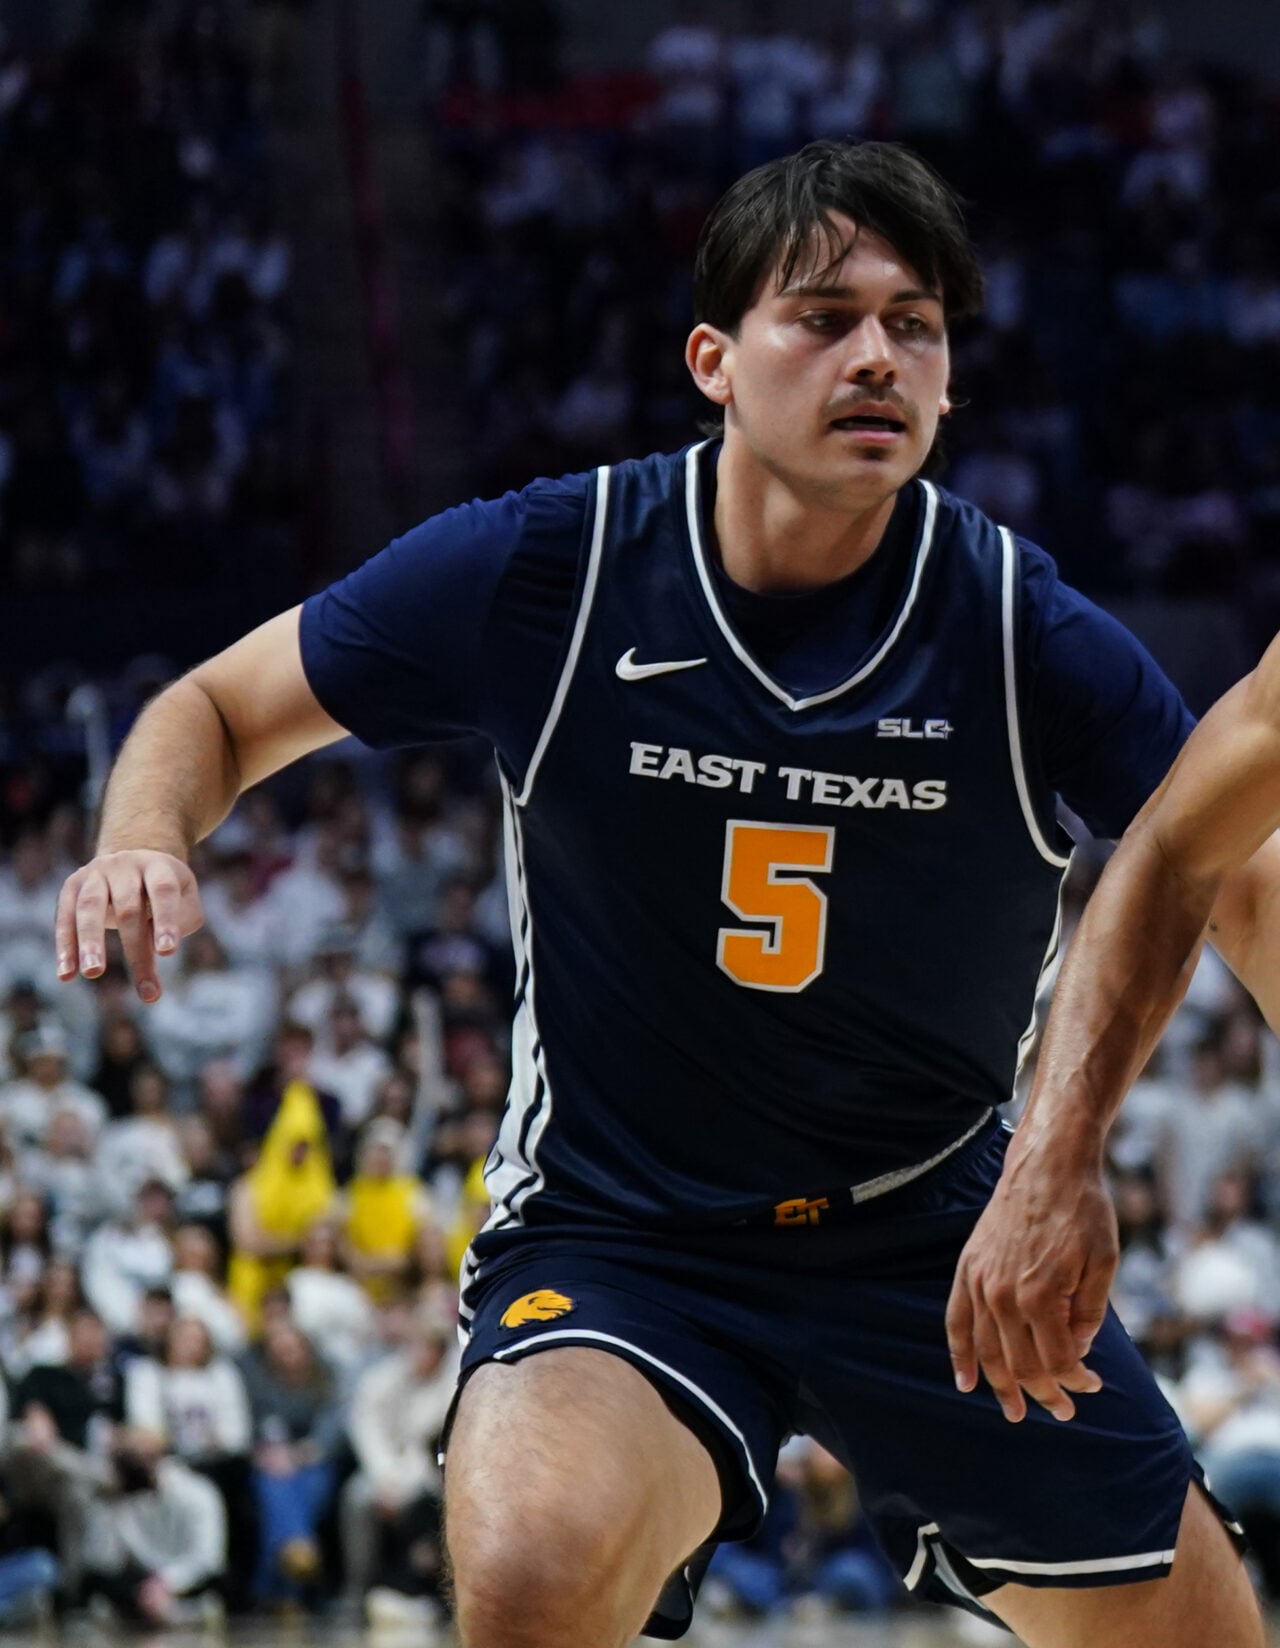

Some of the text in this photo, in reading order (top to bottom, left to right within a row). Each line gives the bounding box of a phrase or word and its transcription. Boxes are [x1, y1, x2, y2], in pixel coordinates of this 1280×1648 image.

[629, 741, 947, 810] EAST TEXAS
[715, 819, 836, 993] 5
